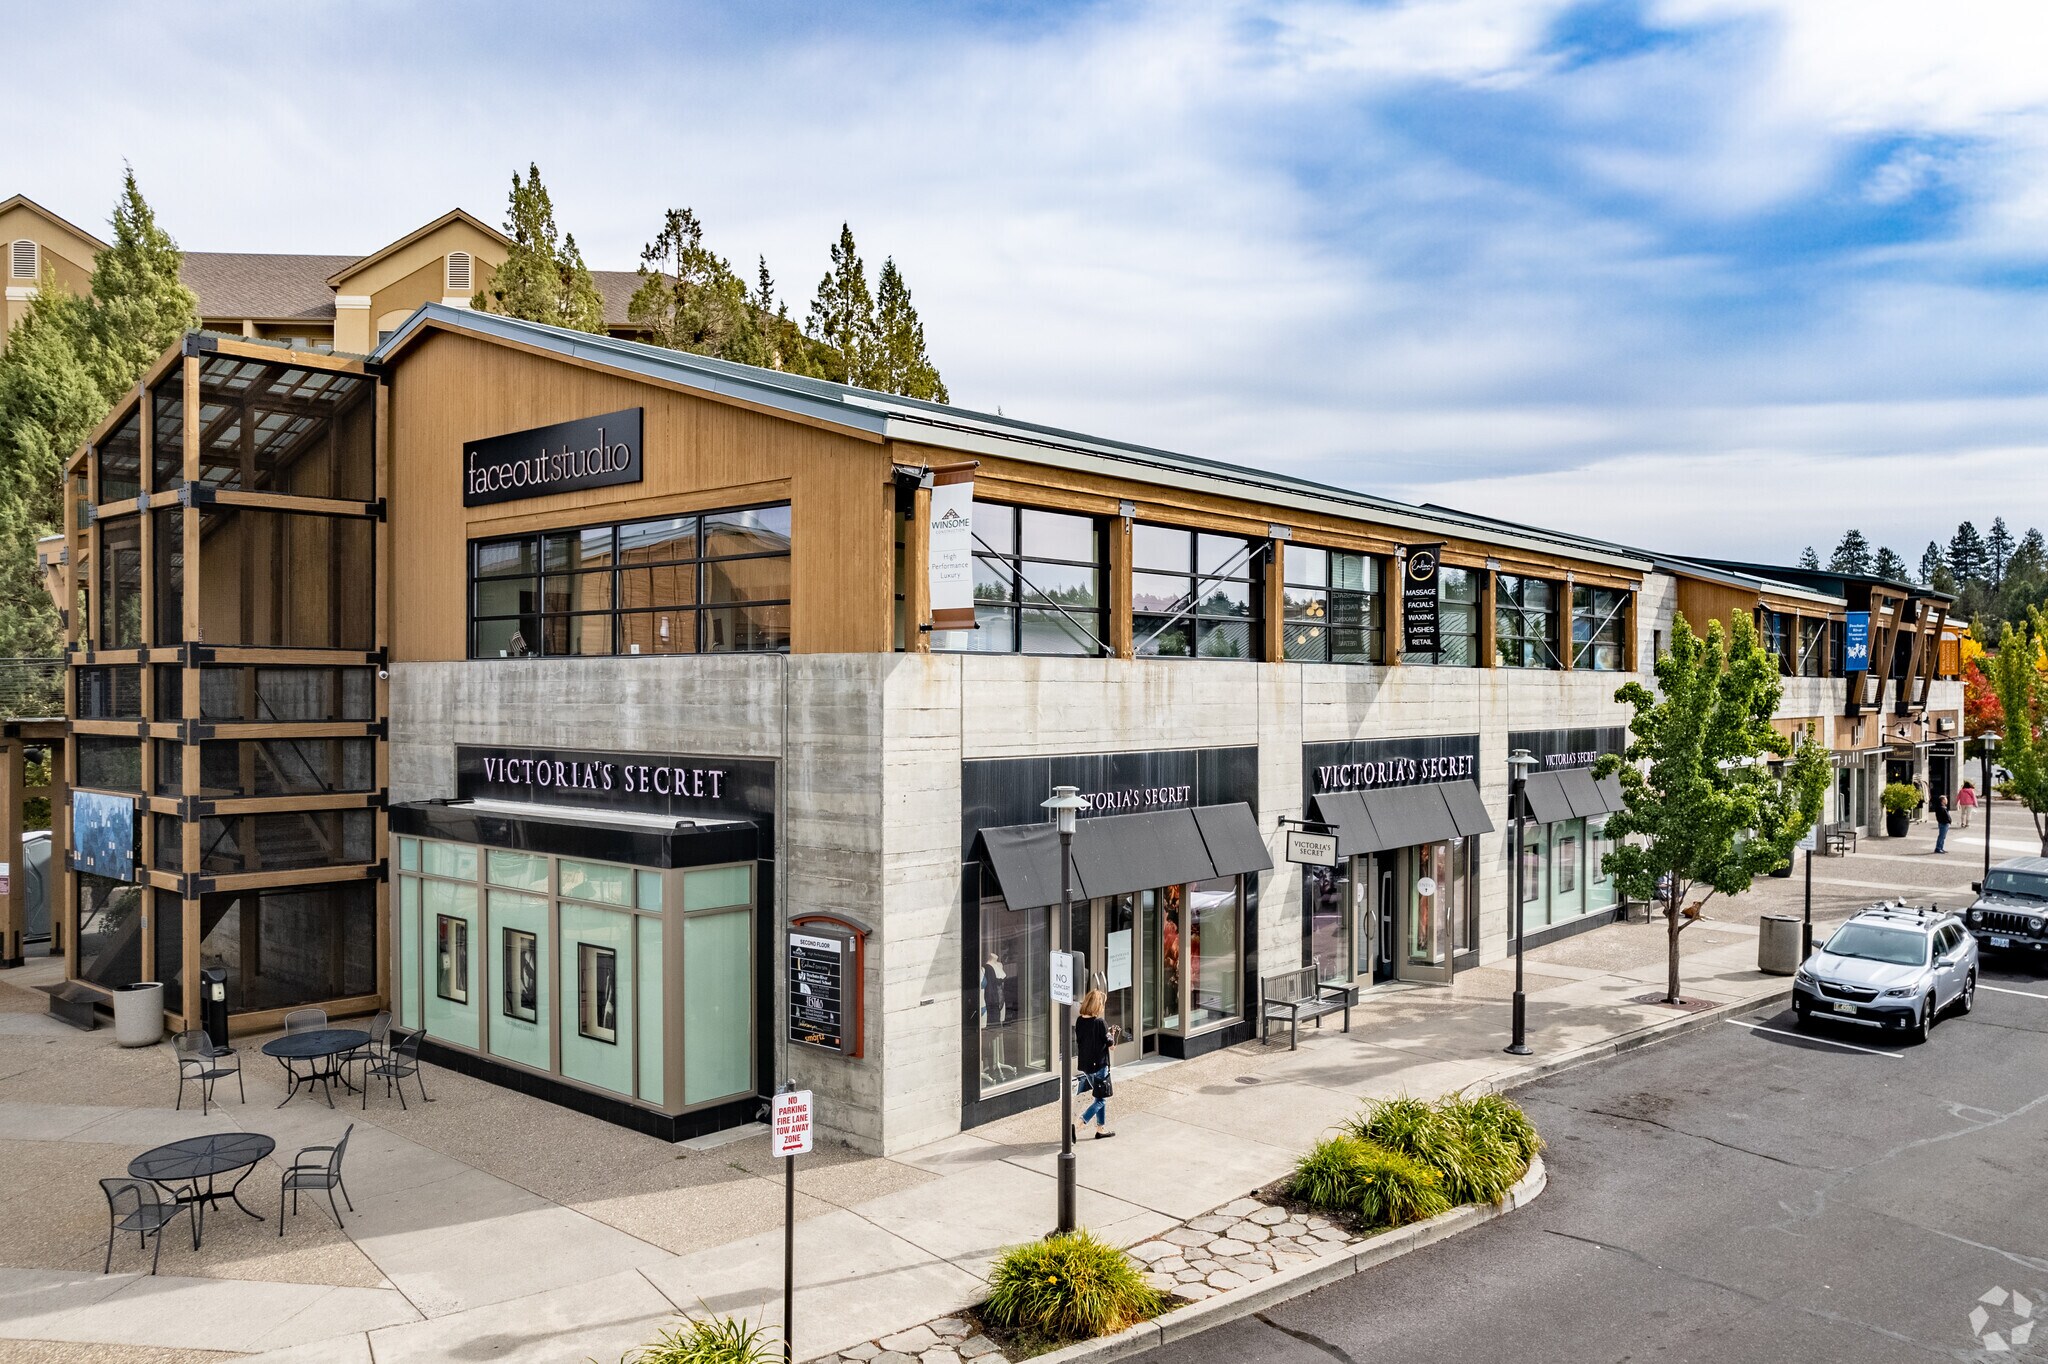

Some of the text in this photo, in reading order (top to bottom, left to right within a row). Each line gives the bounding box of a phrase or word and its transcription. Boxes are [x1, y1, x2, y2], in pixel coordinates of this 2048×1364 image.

[931, 518, 970, 529] WINSOME
[943, 553, 957, 561] High
[931, 562, 969, 570] Performance
[1405, 588, 1436, 596] MASSAGE
[1407, 601, 1434, 609] FACIALS
[1408, 613, 1434, 621] WAXING
[1408, 626, 1435, 634] LASHES
[1411, 638, 1433, 646] RETAIL
[1545, 751, 1598, 766] VICTORIA'S SECRET
[1319, 755, 1474, 789] VICTORIA'S SECRET
[483, 757, 724, 799] VICTORIA'S SECRET
[1075, 786, 1191, 811] CTORIA'S SECRET
[1294, 840, 1331, 851] VICTORIA'S
[1299, 848, 1324, 857] SECRET
[1055, 974, 1067, 983] NO
[788, 1096, 798, 1105] NO
[778, 1104, 807, 1116] PARKING
[776, 1114, 808, 1126] FIRE LANE
[776, 1123, 809, 1135] TOW AWAY
[784, 1134, 801, 1144] ZONE
